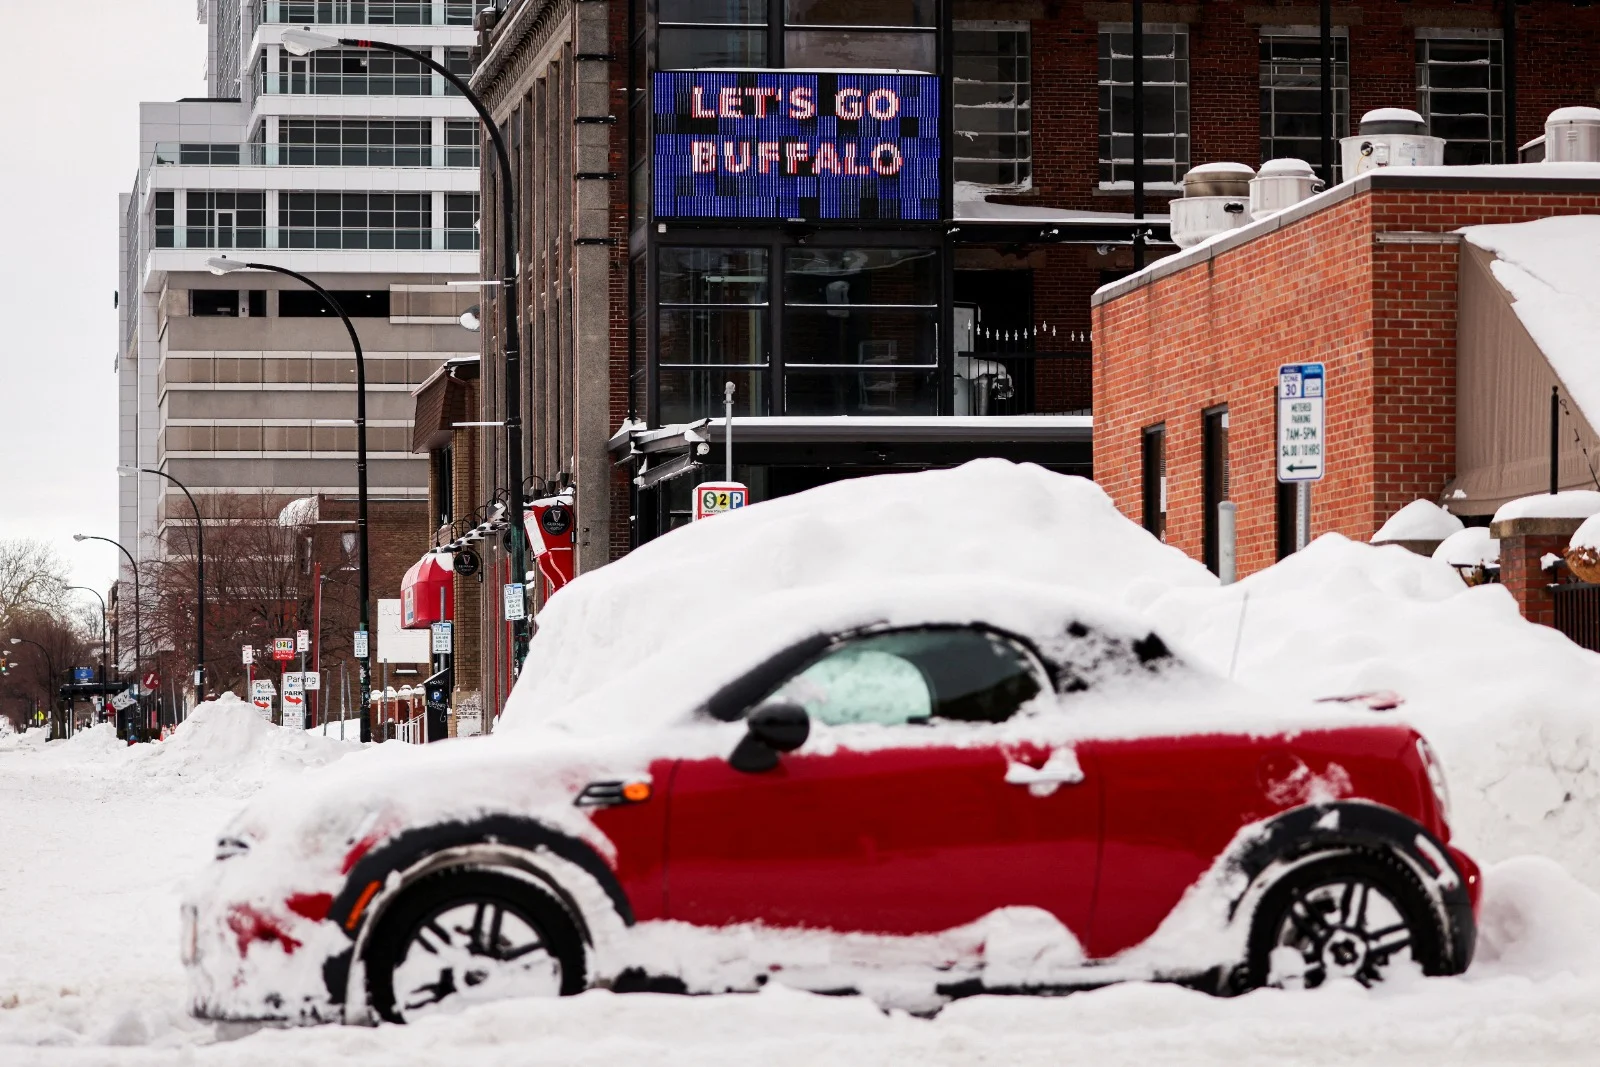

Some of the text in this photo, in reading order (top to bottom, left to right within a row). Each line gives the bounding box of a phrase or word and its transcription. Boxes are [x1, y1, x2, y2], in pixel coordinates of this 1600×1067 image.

[691, 85, 900, 121] LET'S GO
[691, 140, 903, 175] BUFFALO
[1283, 374, 1298, 383] ZONE
[1285, 383, 1297, 396] 30
[1291, 402, 1312, 412] METERED
[1291, 414, 1311, 424] PARKING
